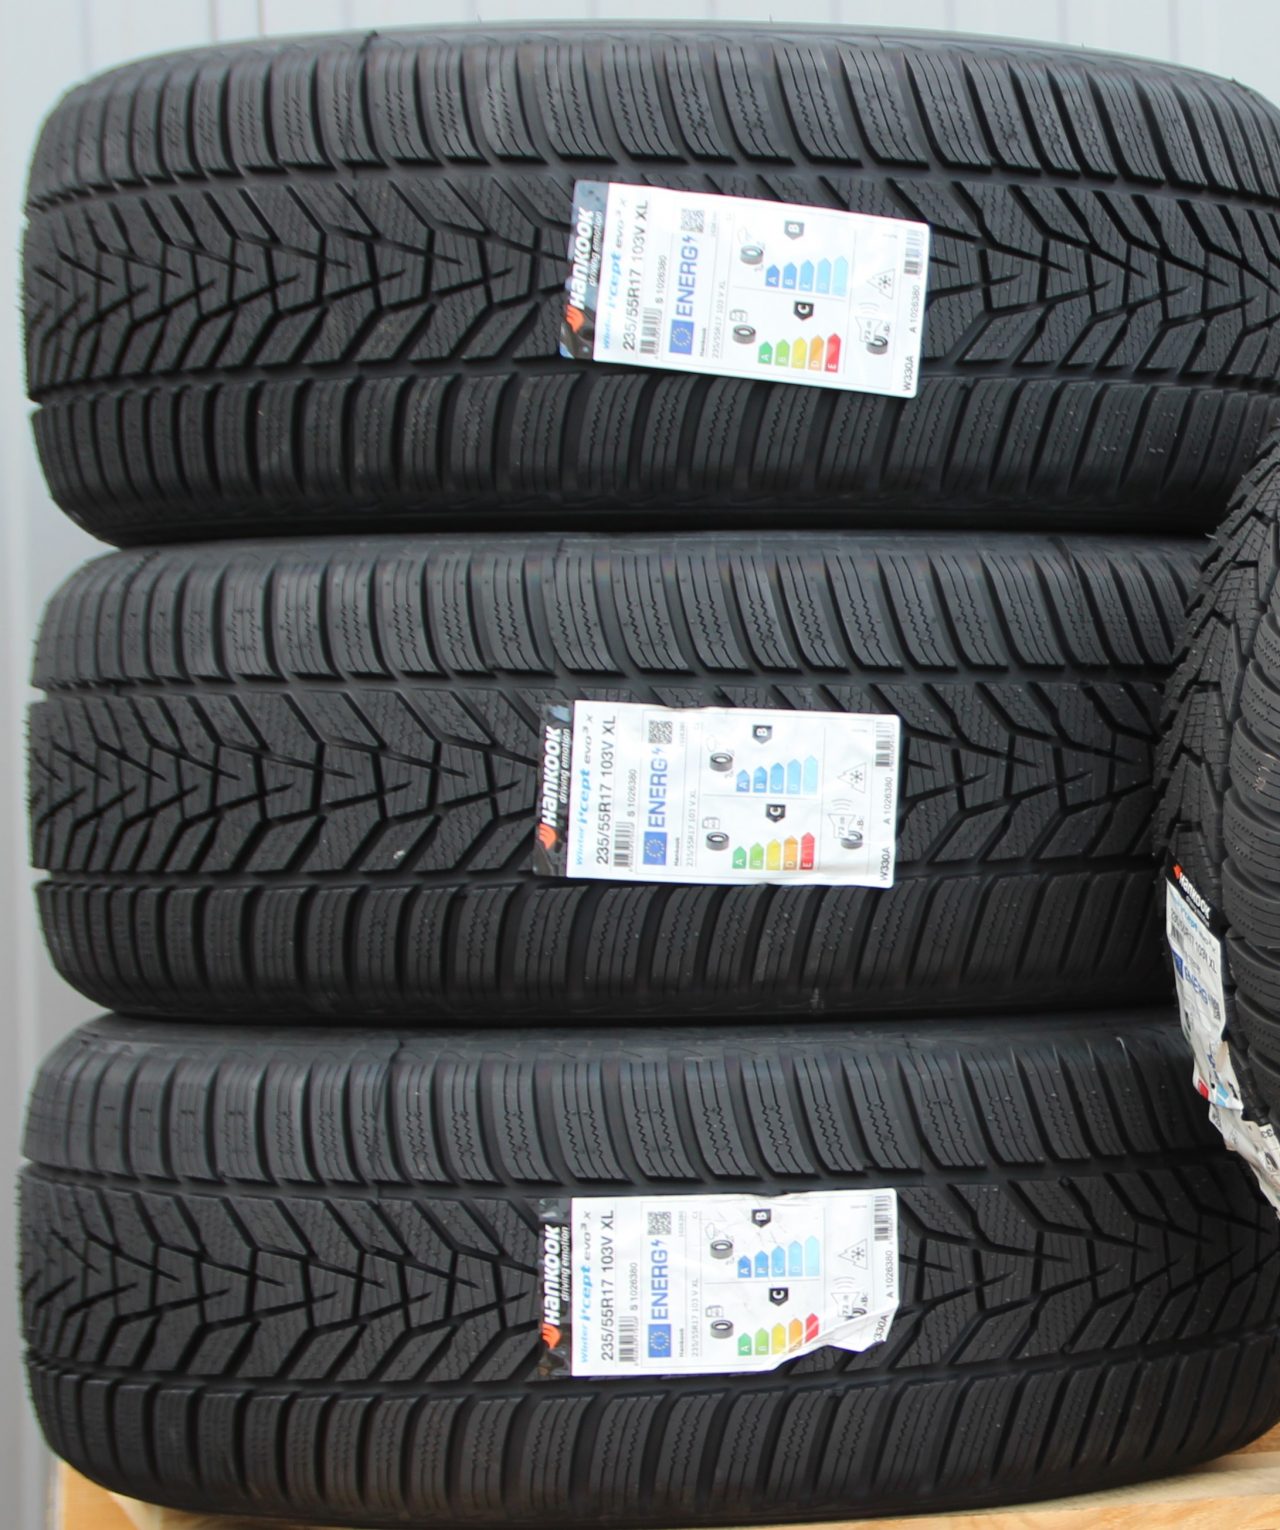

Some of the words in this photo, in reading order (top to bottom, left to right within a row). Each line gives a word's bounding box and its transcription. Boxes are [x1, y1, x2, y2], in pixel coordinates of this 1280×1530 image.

[635, 200, 648, 221] XL
[788, 225, 798, 233] B
[592, 211, 603, 252] emotion
[631, 225, 645, 262] 103V
[656, 255, 667, 293] 1026380
[676, 246, 698, 317] ENERG
[622, 269, 641, 351] 235/55R17
[798, 304, 810, 315] C
[911, 285, 920, 323] 1026380
[712, 316, 722, 358] 235/55R17
[902, 355, 914, 392] W330A
[602, 715, 615, 735] XL
[756, 728, 766, 736] B
[560, 729, 570, 768] emotion
[601, 740, 613, 777] 103V
[558, 770, 569, 803] driving
[628, 769, 636, 807] 1026380
[648, 758, 668, 828] ENERG
[884, 777, 892, 814] 1026380
[596, 783, 612, 865] 235/55R17
[770, 806, 781, 816] C
[686, 825, 695, 867] 235/55R17
[879, 847, 890, 880] W330A
[601, 1210, 613, 1231] XL
[755, 1212, 767, 1220] B
[561, 1227, 569, 1266] emotion
[601, 1236, 613, 1272] 103V
[561, 1268, 570, 1301] driving
[630, 1263, 638, 1301] 1026380
[651, 1250, 668, 1320] ENERG
[773, 1290, 785, 1300] C
[601, 1279, 613, 1360] 235/55R17
